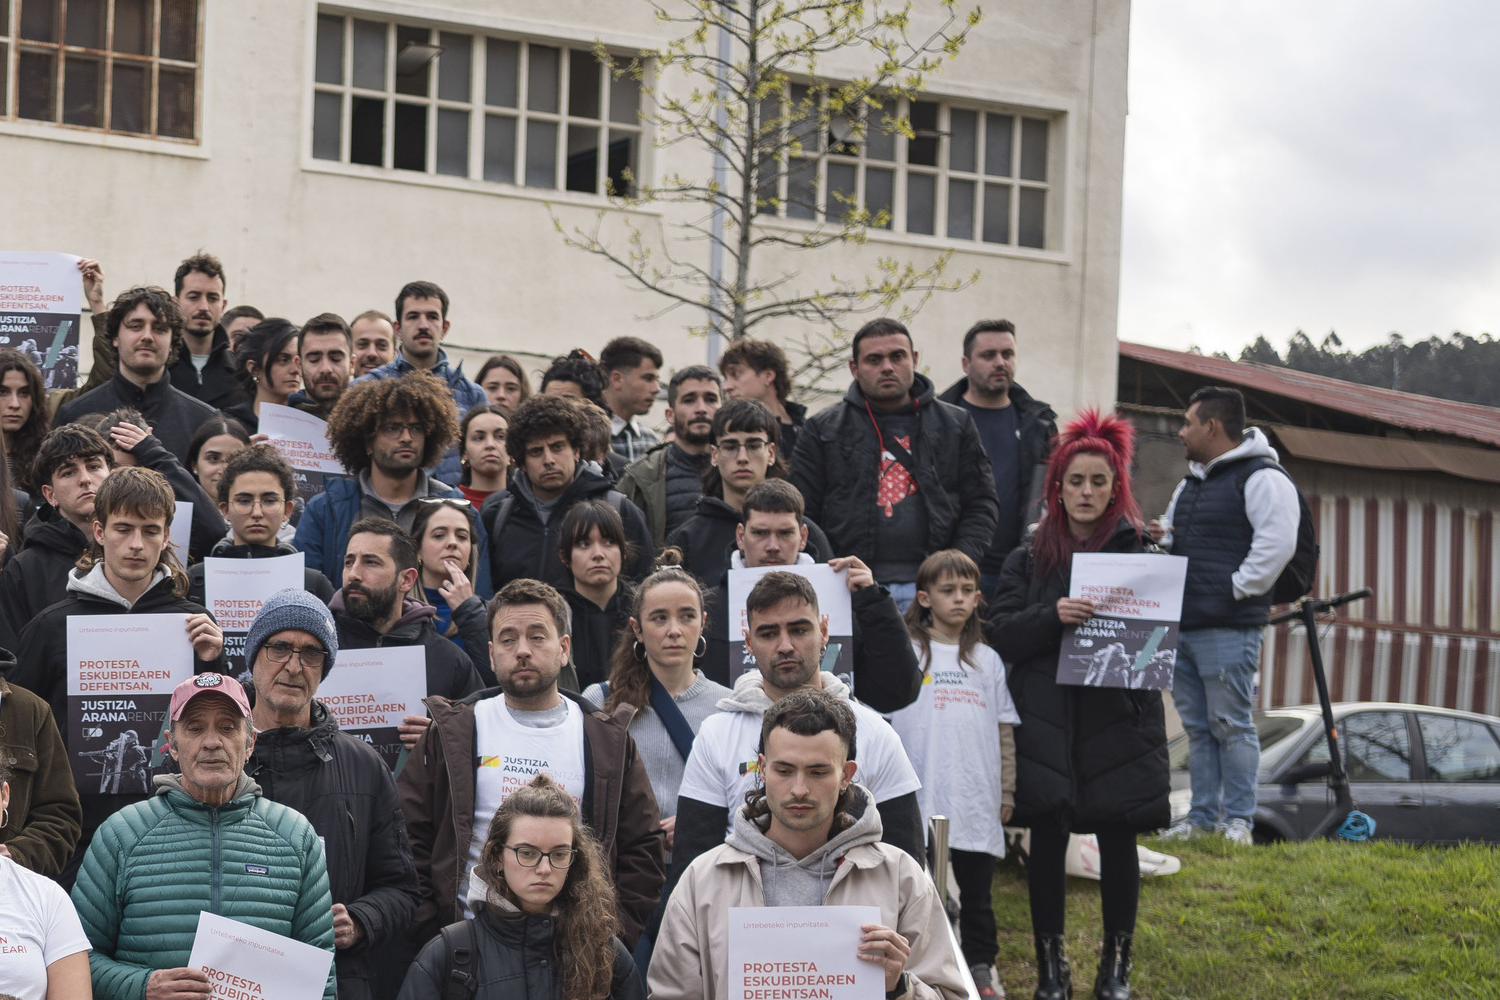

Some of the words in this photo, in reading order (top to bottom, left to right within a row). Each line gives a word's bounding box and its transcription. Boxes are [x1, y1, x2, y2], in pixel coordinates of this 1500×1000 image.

[214, 600, 263, 608] PROTESTA
[214, 610, 260, 618] ESKUBID
[1083, 618, 1126, 630] USTIZIA
[79, 660, 140, 669] PROTESTA
[79, 671, 171, 680] ESKUBIDEAREN
[80, 682, 153, 692] DEFENTSAN,
[81, 700, 136, 711] JUSTIZIA
[331, 703, 406, 716] KUBIDEAREN
[503, 756, 549, 768] JUSTIZIA
[210, 928, 247, 945] Urtebeteko
[743, 962, 818, 973] PROTESTA
[201, 965, 262, 994] PROTESTA
[743, 974, 856, 987] ESKUBIDEAREN
[743, 988, 833, 1000] DEFENTSAN,
